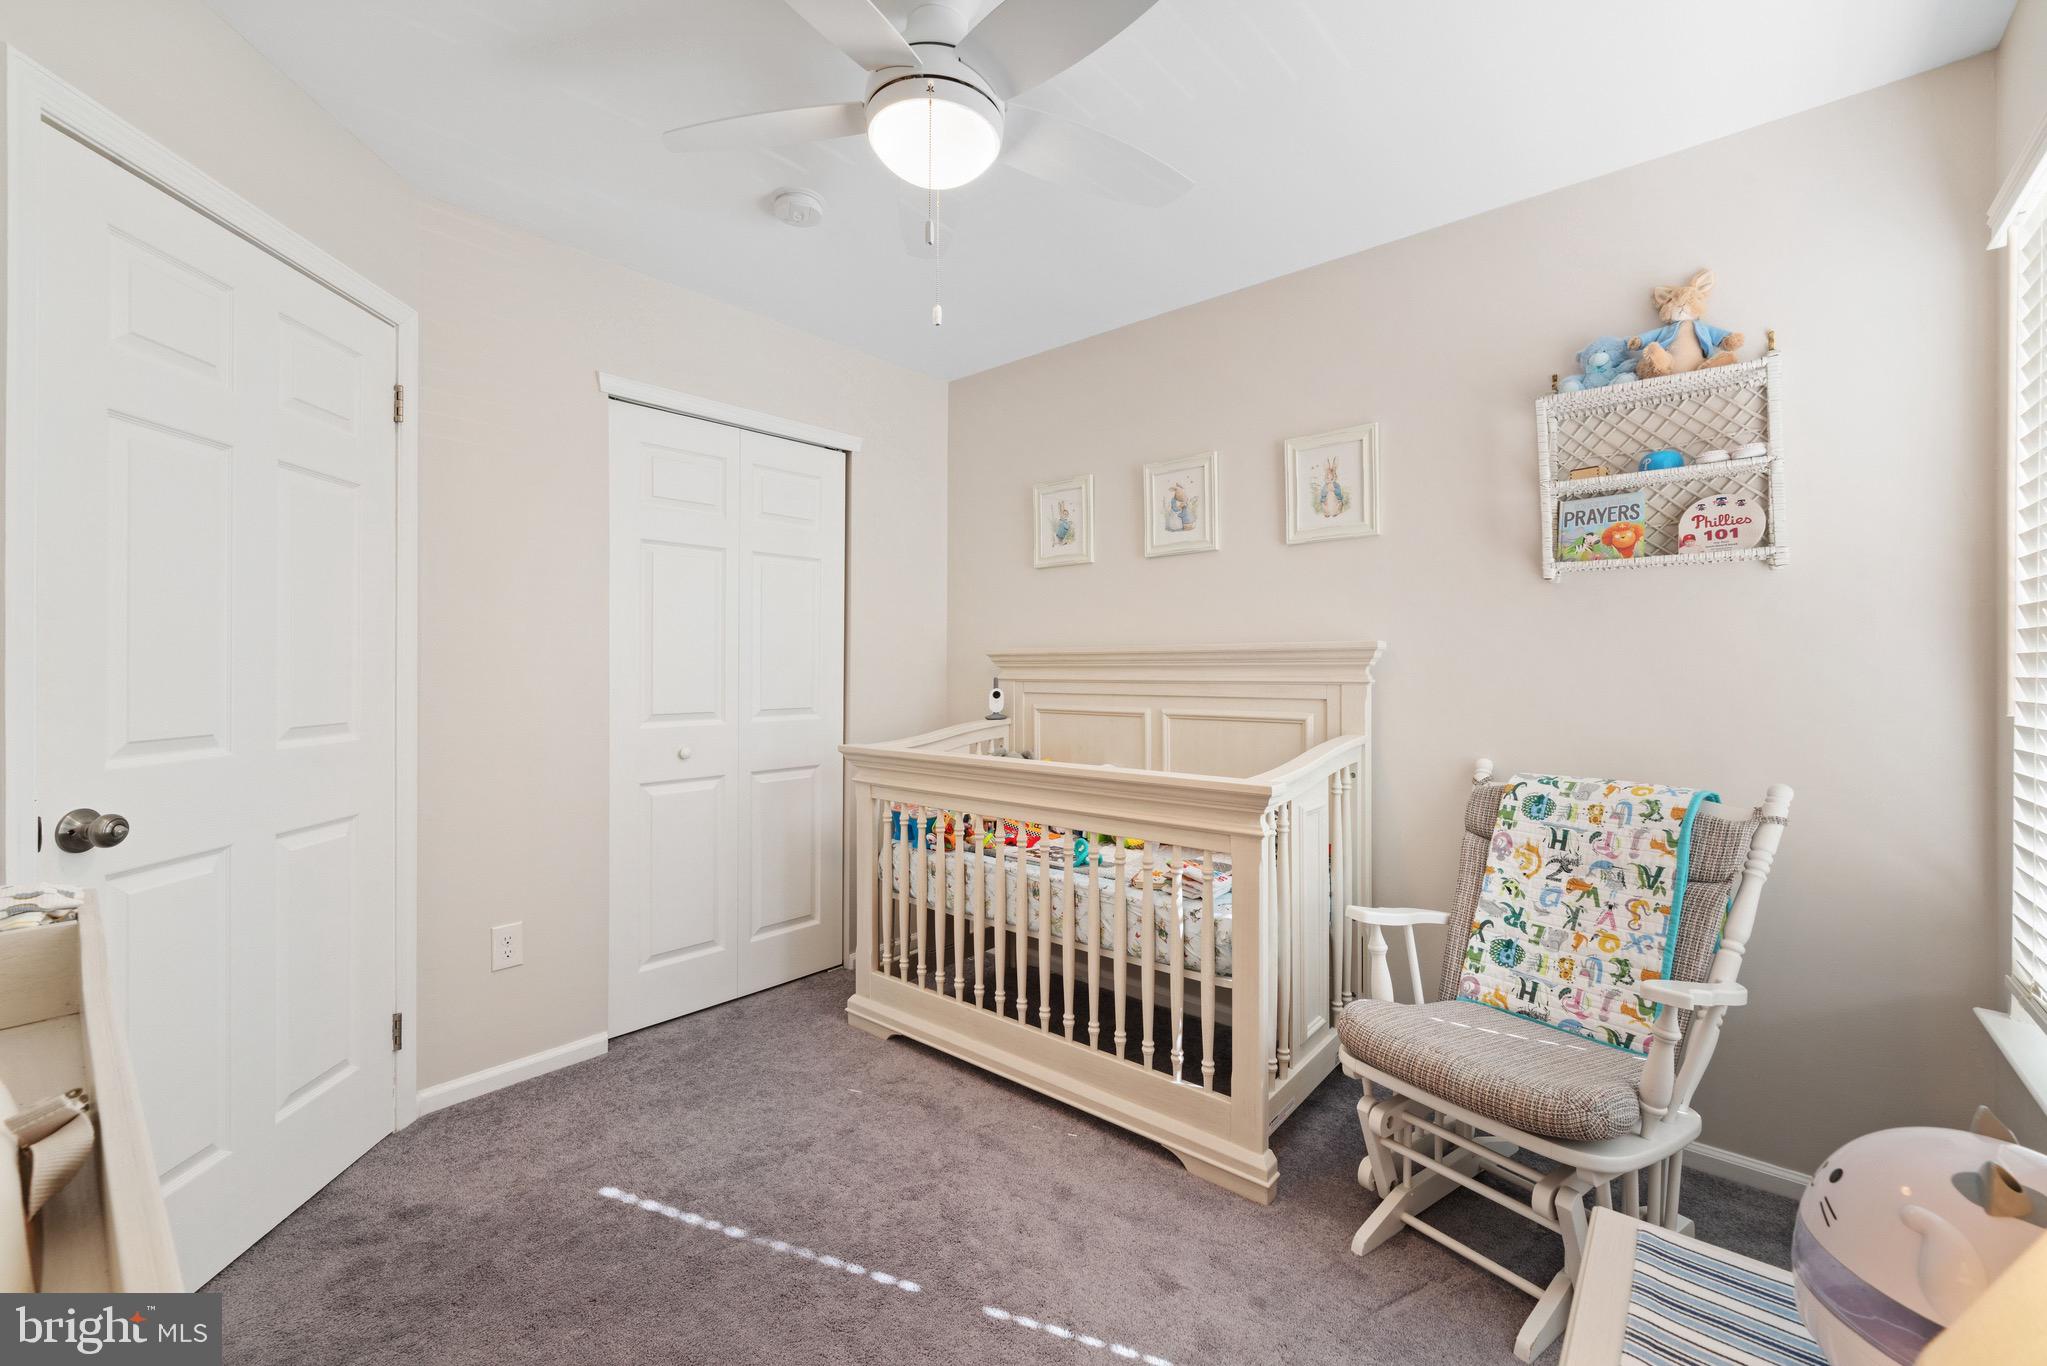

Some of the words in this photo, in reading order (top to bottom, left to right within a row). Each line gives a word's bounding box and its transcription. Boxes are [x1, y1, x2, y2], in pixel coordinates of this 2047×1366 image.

[1563, 503, 1640, 527] PRAYERS
[1691, 513, 1752, 529] Phillies
[1704, 528, 1739, 541] 101
[1548, 827, 1569, 851] H
[1519, 977, 1539, 1003] H
